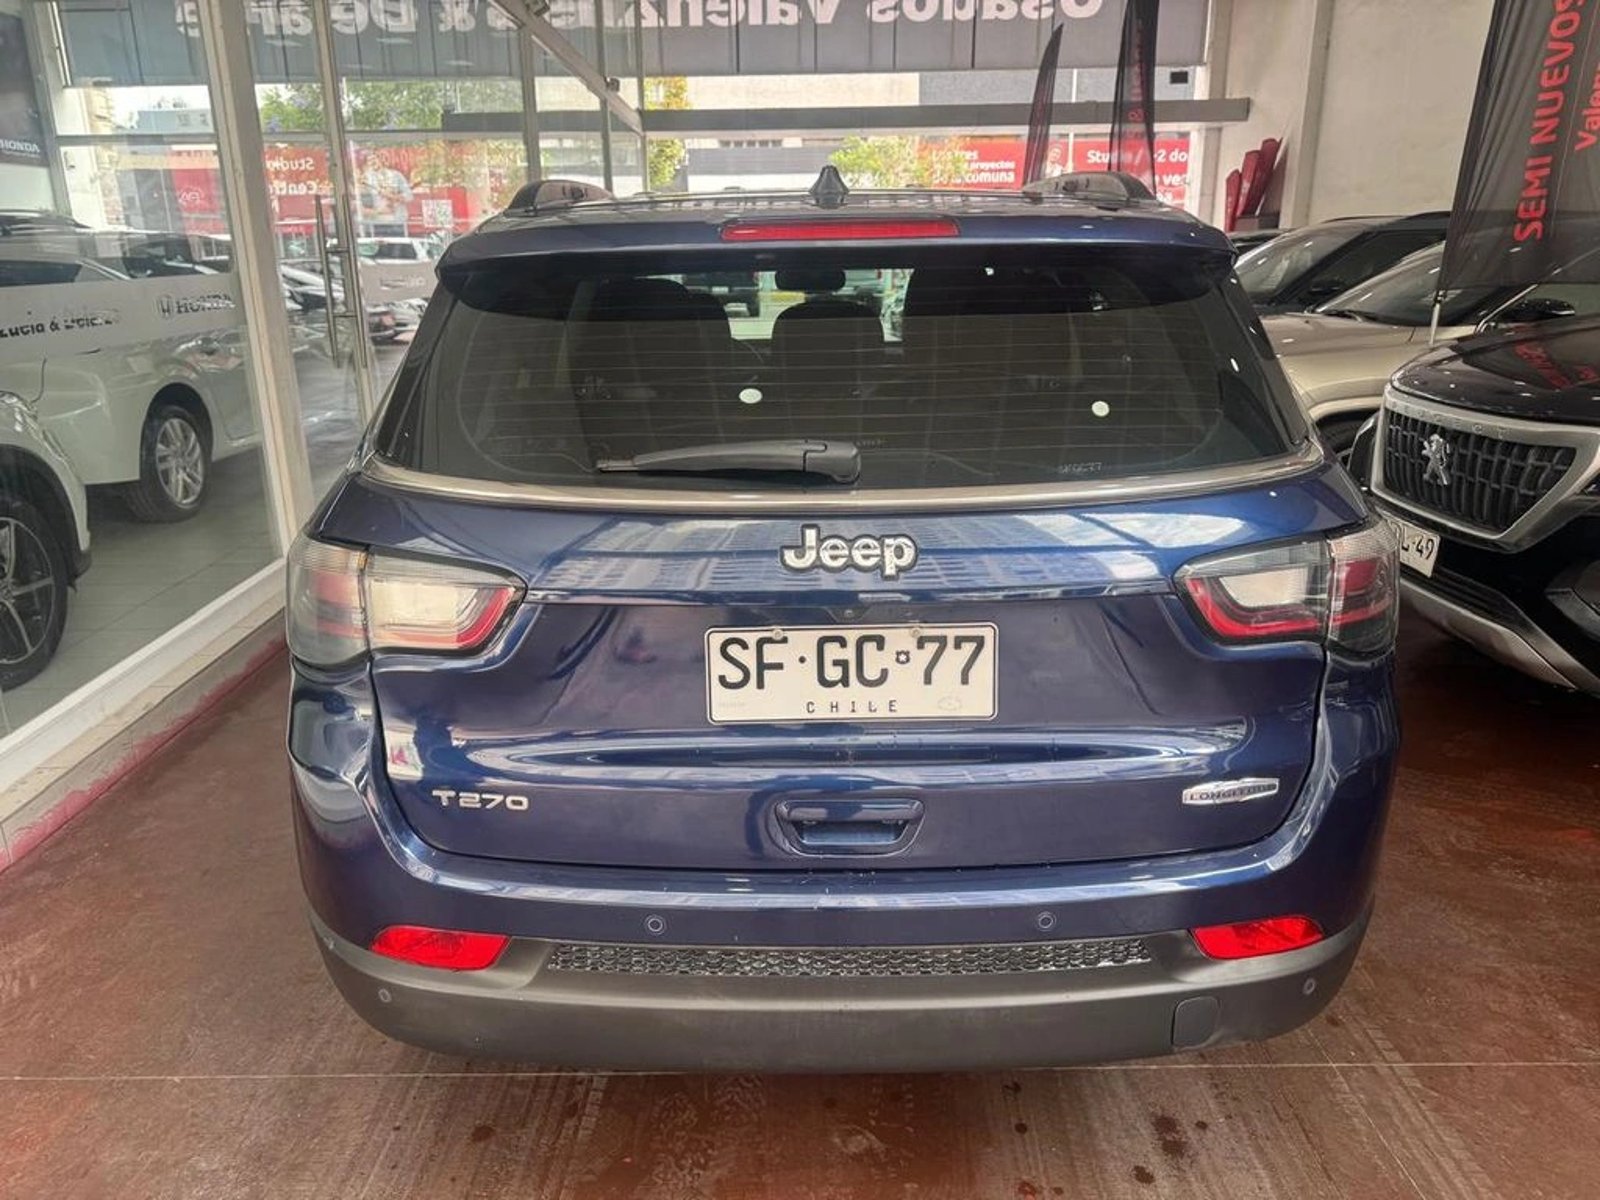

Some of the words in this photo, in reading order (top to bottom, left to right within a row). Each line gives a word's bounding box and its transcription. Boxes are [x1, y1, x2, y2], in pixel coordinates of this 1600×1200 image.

[964, 171, 1015, 184] comuna
[1513, 155, 1553, 242] SEMI
[780, 523, 918, 579] Jeep
[806, 699, 898, 714] CHILE
[431, 788, 530, 811] T270
